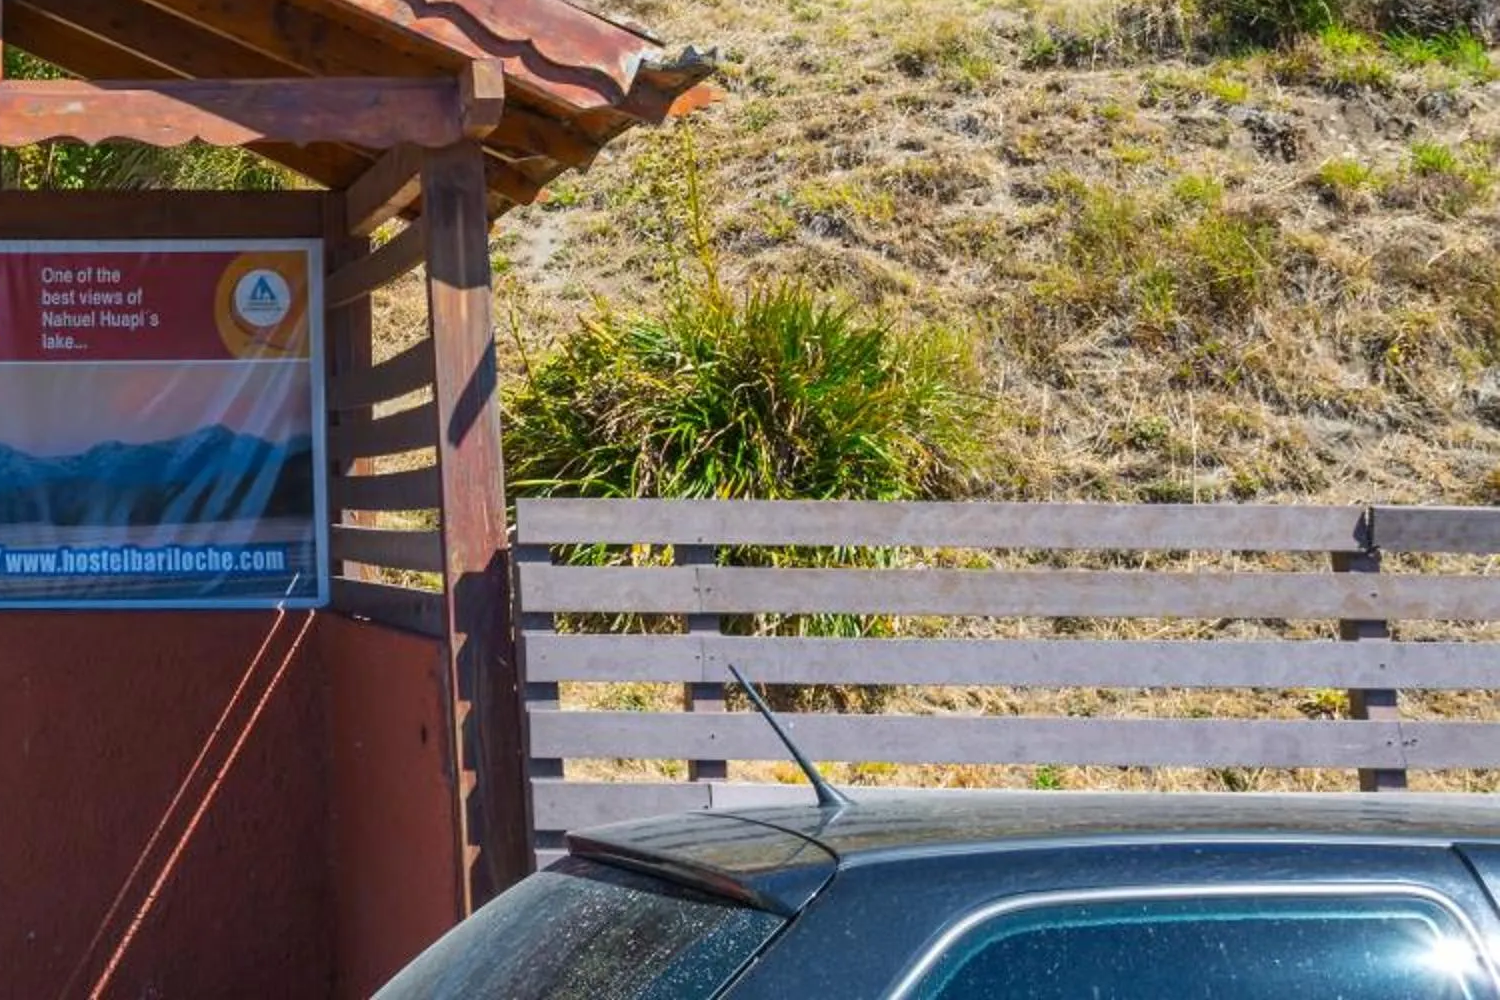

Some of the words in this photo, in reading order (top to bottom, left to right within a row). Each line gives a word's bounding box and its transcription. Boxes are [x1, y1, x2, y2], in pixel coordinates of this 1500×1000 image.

[41, 266, 73, 283] One
[77, 266, 93, 283] of
[96, 266, 121, 283] the
[41, 288, 75, 305] best
[79, 290, 123, 305] views
[127, 286, 143, 305] of
[41, 310, 96, 327] Nahuel
[5, 548, 285, 573] www.hostelbariloche.com
